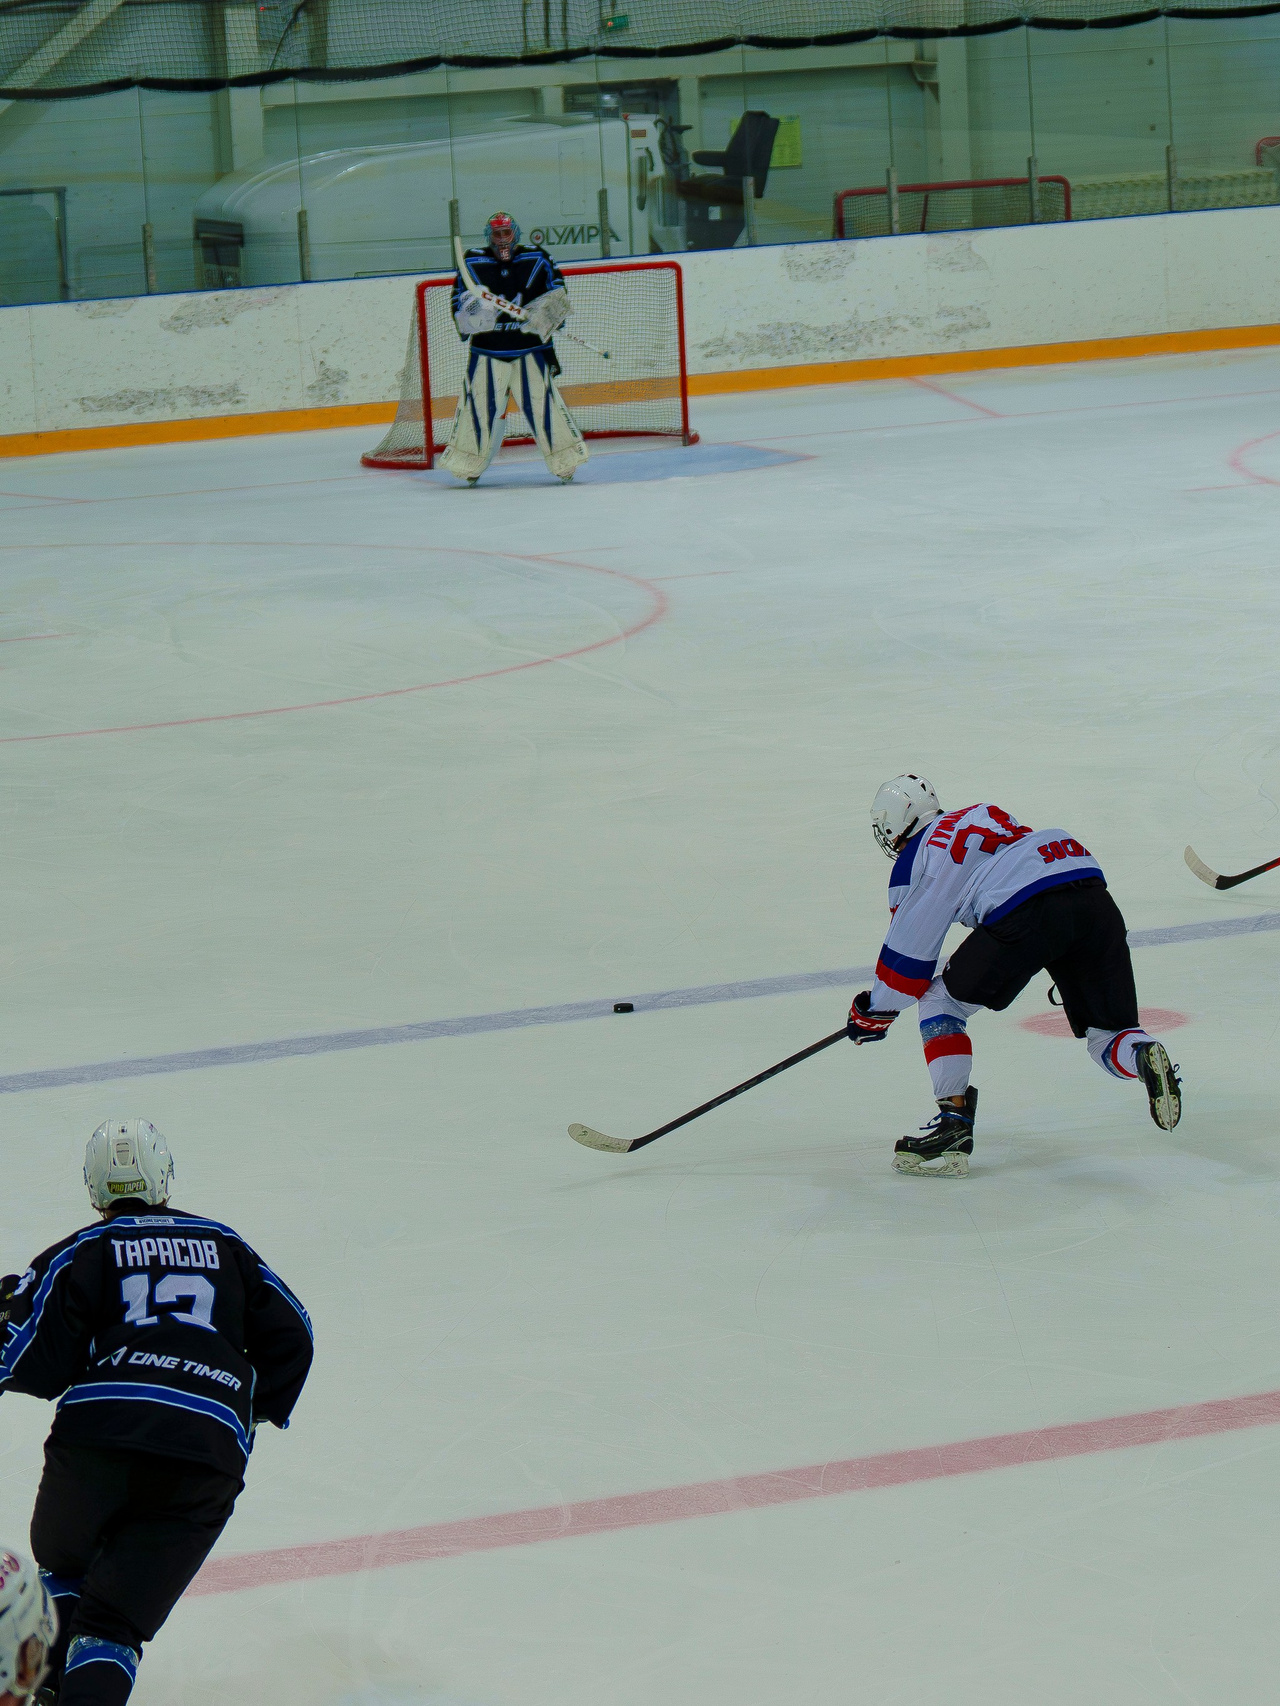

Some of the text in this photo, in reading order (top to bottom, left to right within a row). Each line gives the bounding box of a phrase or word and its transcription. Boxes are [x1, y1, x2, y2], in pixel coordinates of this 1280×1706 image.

[530, 225, 620, 246] OLYMPA
[481, 291, 521, 315] CCM
[110, 1238, 220, 1270] ТАРАСОВ
[128, 1351, 242, 1392] ONE TIMER
